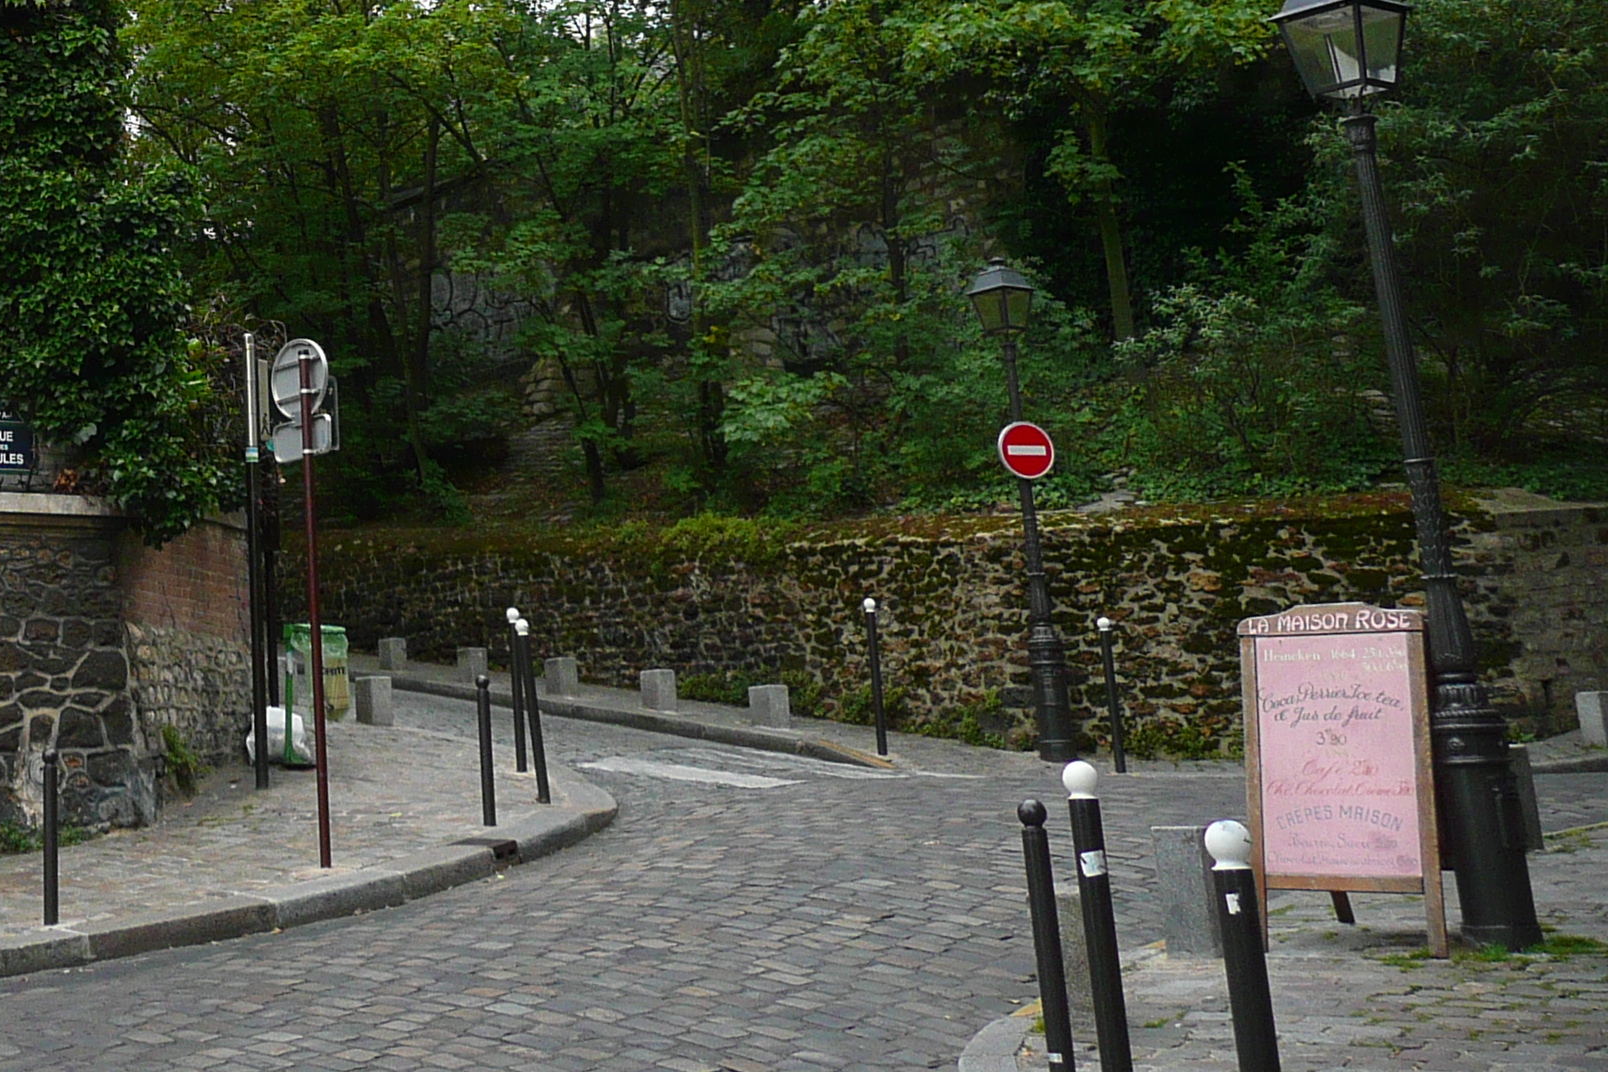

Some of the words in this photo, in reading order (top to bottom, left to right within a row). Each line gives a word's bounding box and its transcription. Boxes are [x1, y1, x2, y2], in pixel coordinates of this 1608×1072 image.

[1248, 618, 1269, 635] LA
[1277, 612, 1348, 632] MAISON
[1355, 609, 1411, 629] ROSE
[1263, 649, 1321, 663] Heineken
[1290, 706, 1319, 728] Jus
[1323, 705, 1342, 721] de
[1342, 705, 1382, 728] fruit
[1338, 804, 1404, 831] MAISON
